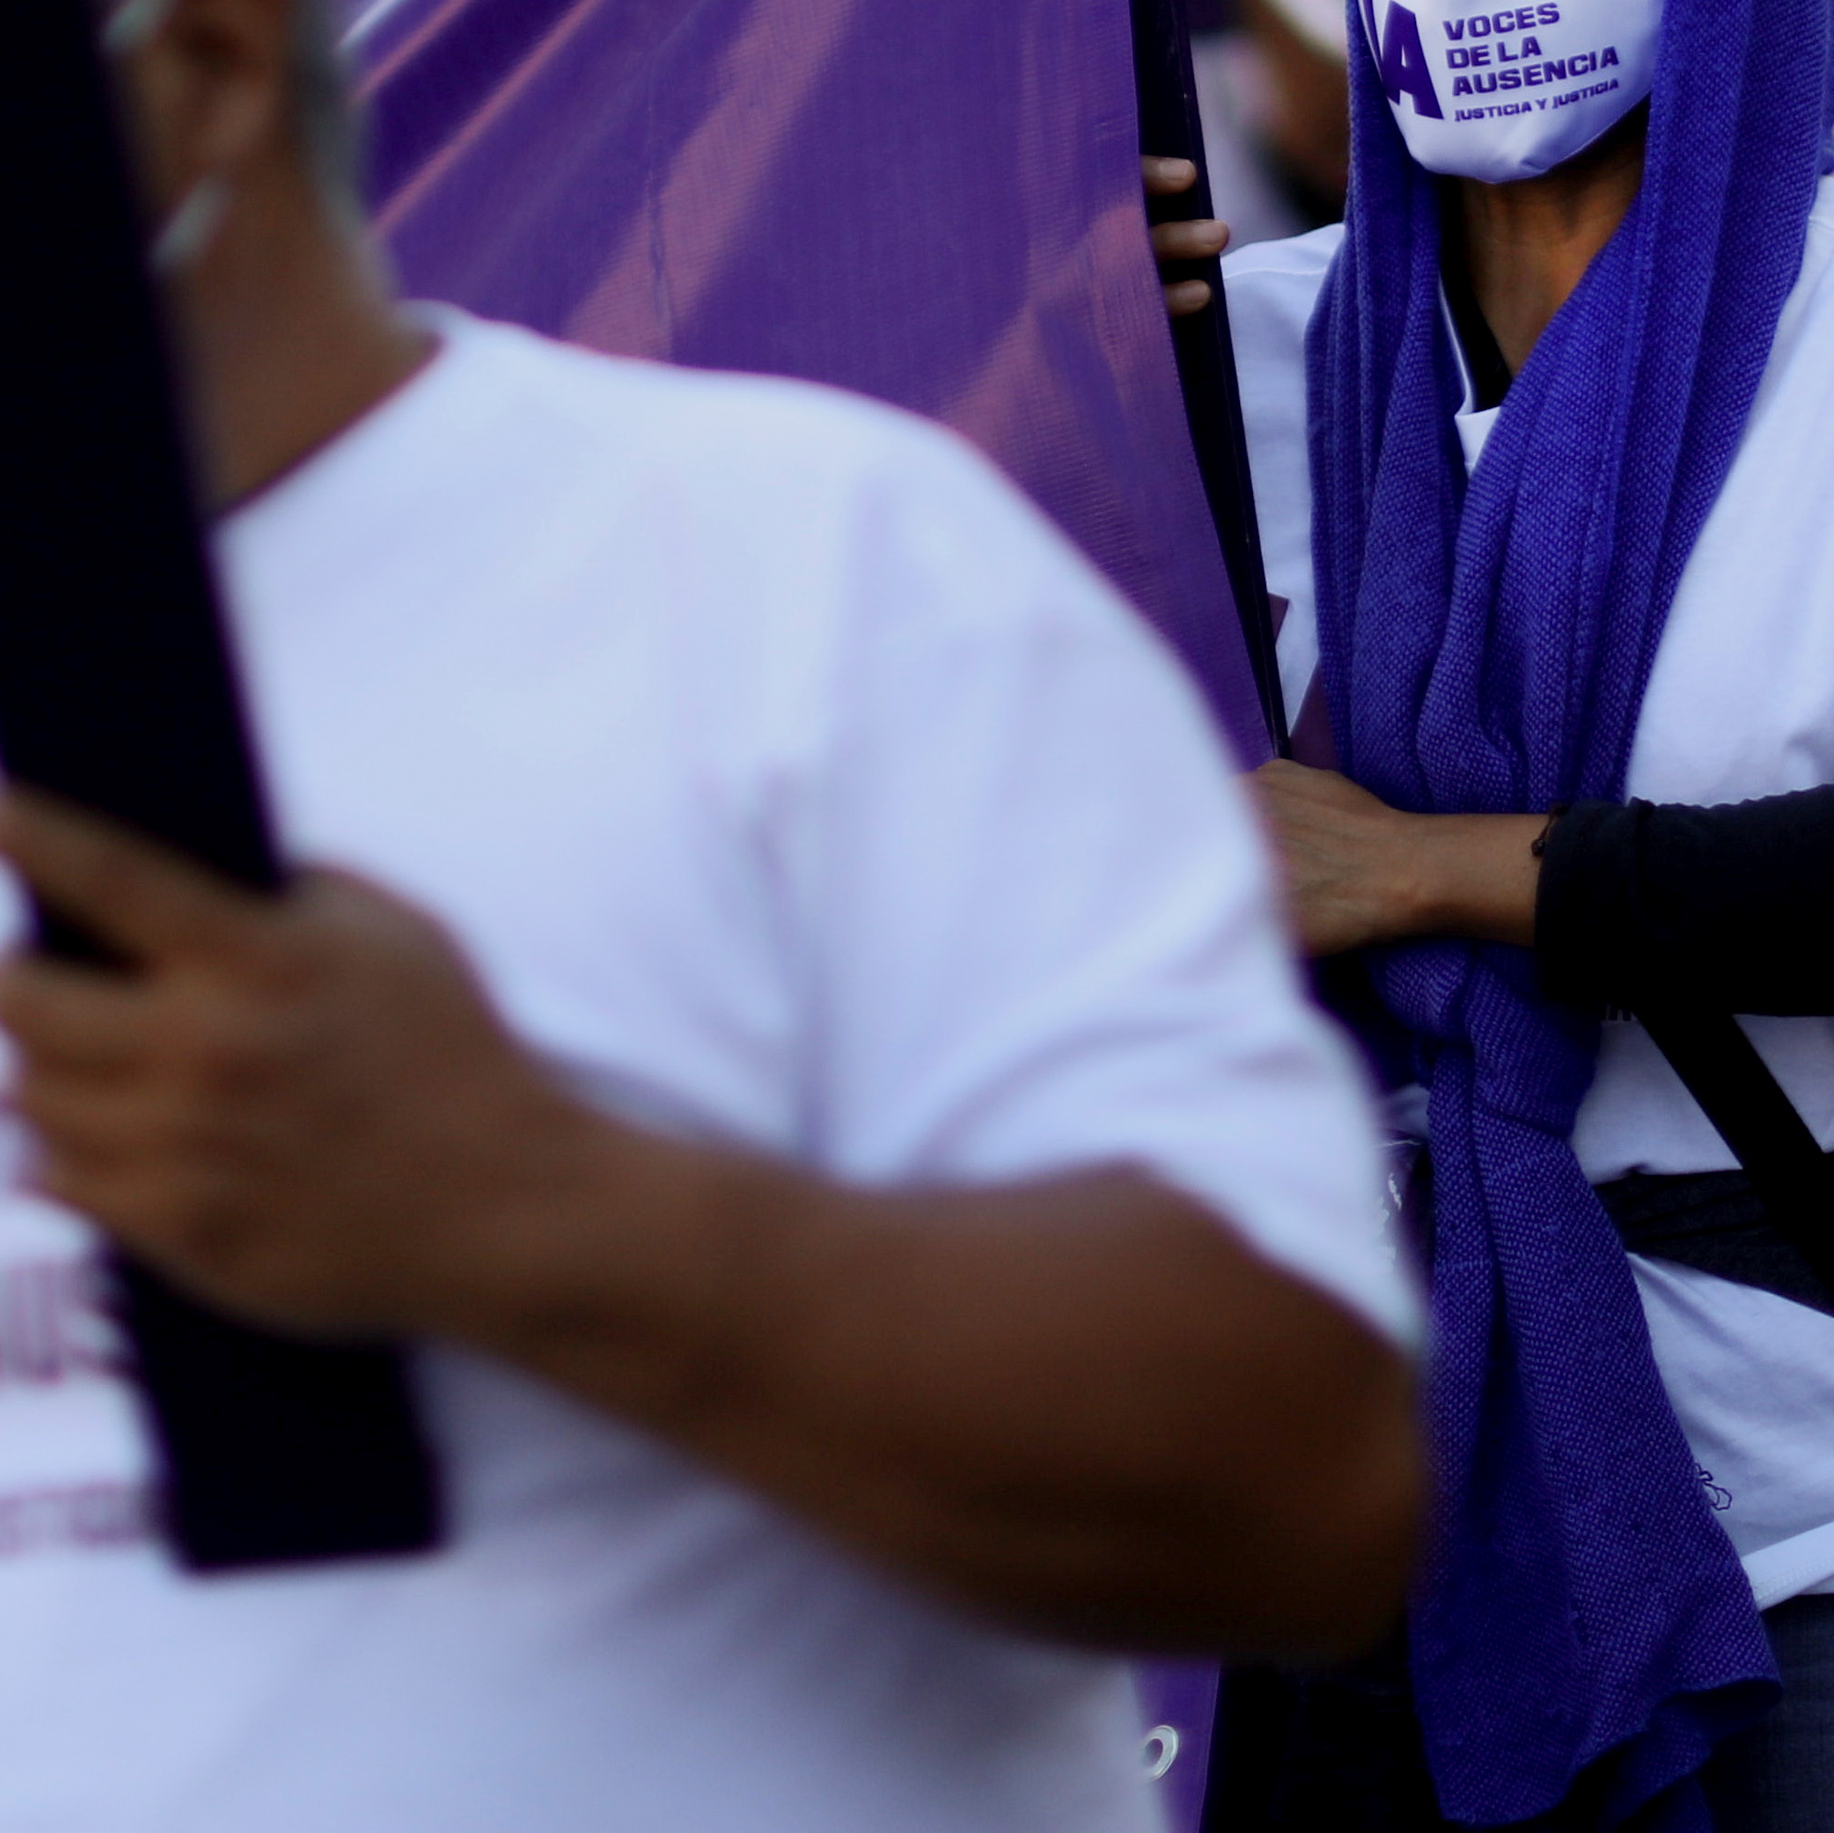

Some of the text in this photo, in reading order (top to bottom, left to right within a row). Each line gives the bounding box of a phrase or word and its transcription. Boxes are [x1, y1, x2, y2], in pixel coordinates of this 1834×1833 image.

[1442, 1, 1560, 41] VOCES
[1446, 35, 1542, 70] DE LA
[1452, 45, 1620, 97] AUSENCIA
[1454, 78, 1620, 122] JUSTICIA Y JUSTICIA
